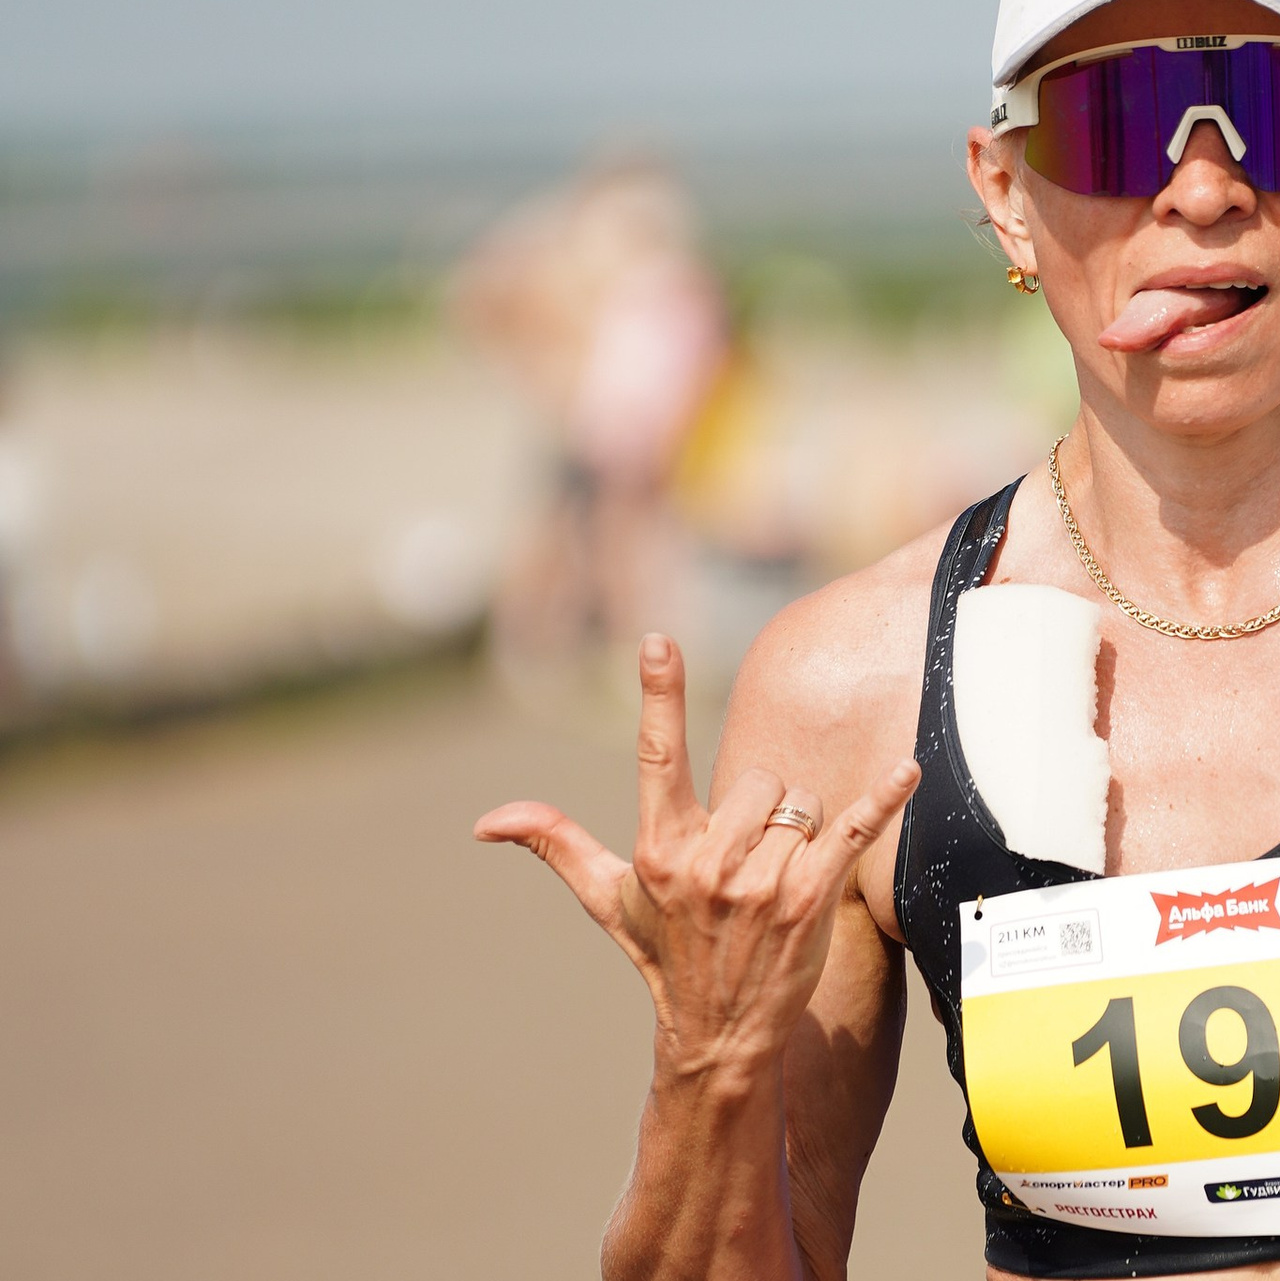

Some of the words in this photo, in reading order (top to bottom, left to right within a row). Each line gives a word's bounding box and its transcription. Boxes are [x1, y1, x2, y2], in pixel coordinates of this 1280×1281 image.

[1195, 36, 1227, 48] BLIZ
[1169, 902, 1225, 923] Альфа
[1226, 899, 1270, 916] Банк
[998, 930, 1019, 943] 21.1
[1130, 1176, 1166, 1188] PRO
[1054, 1204, 1158, 1219] РОСГОССТРАХ
